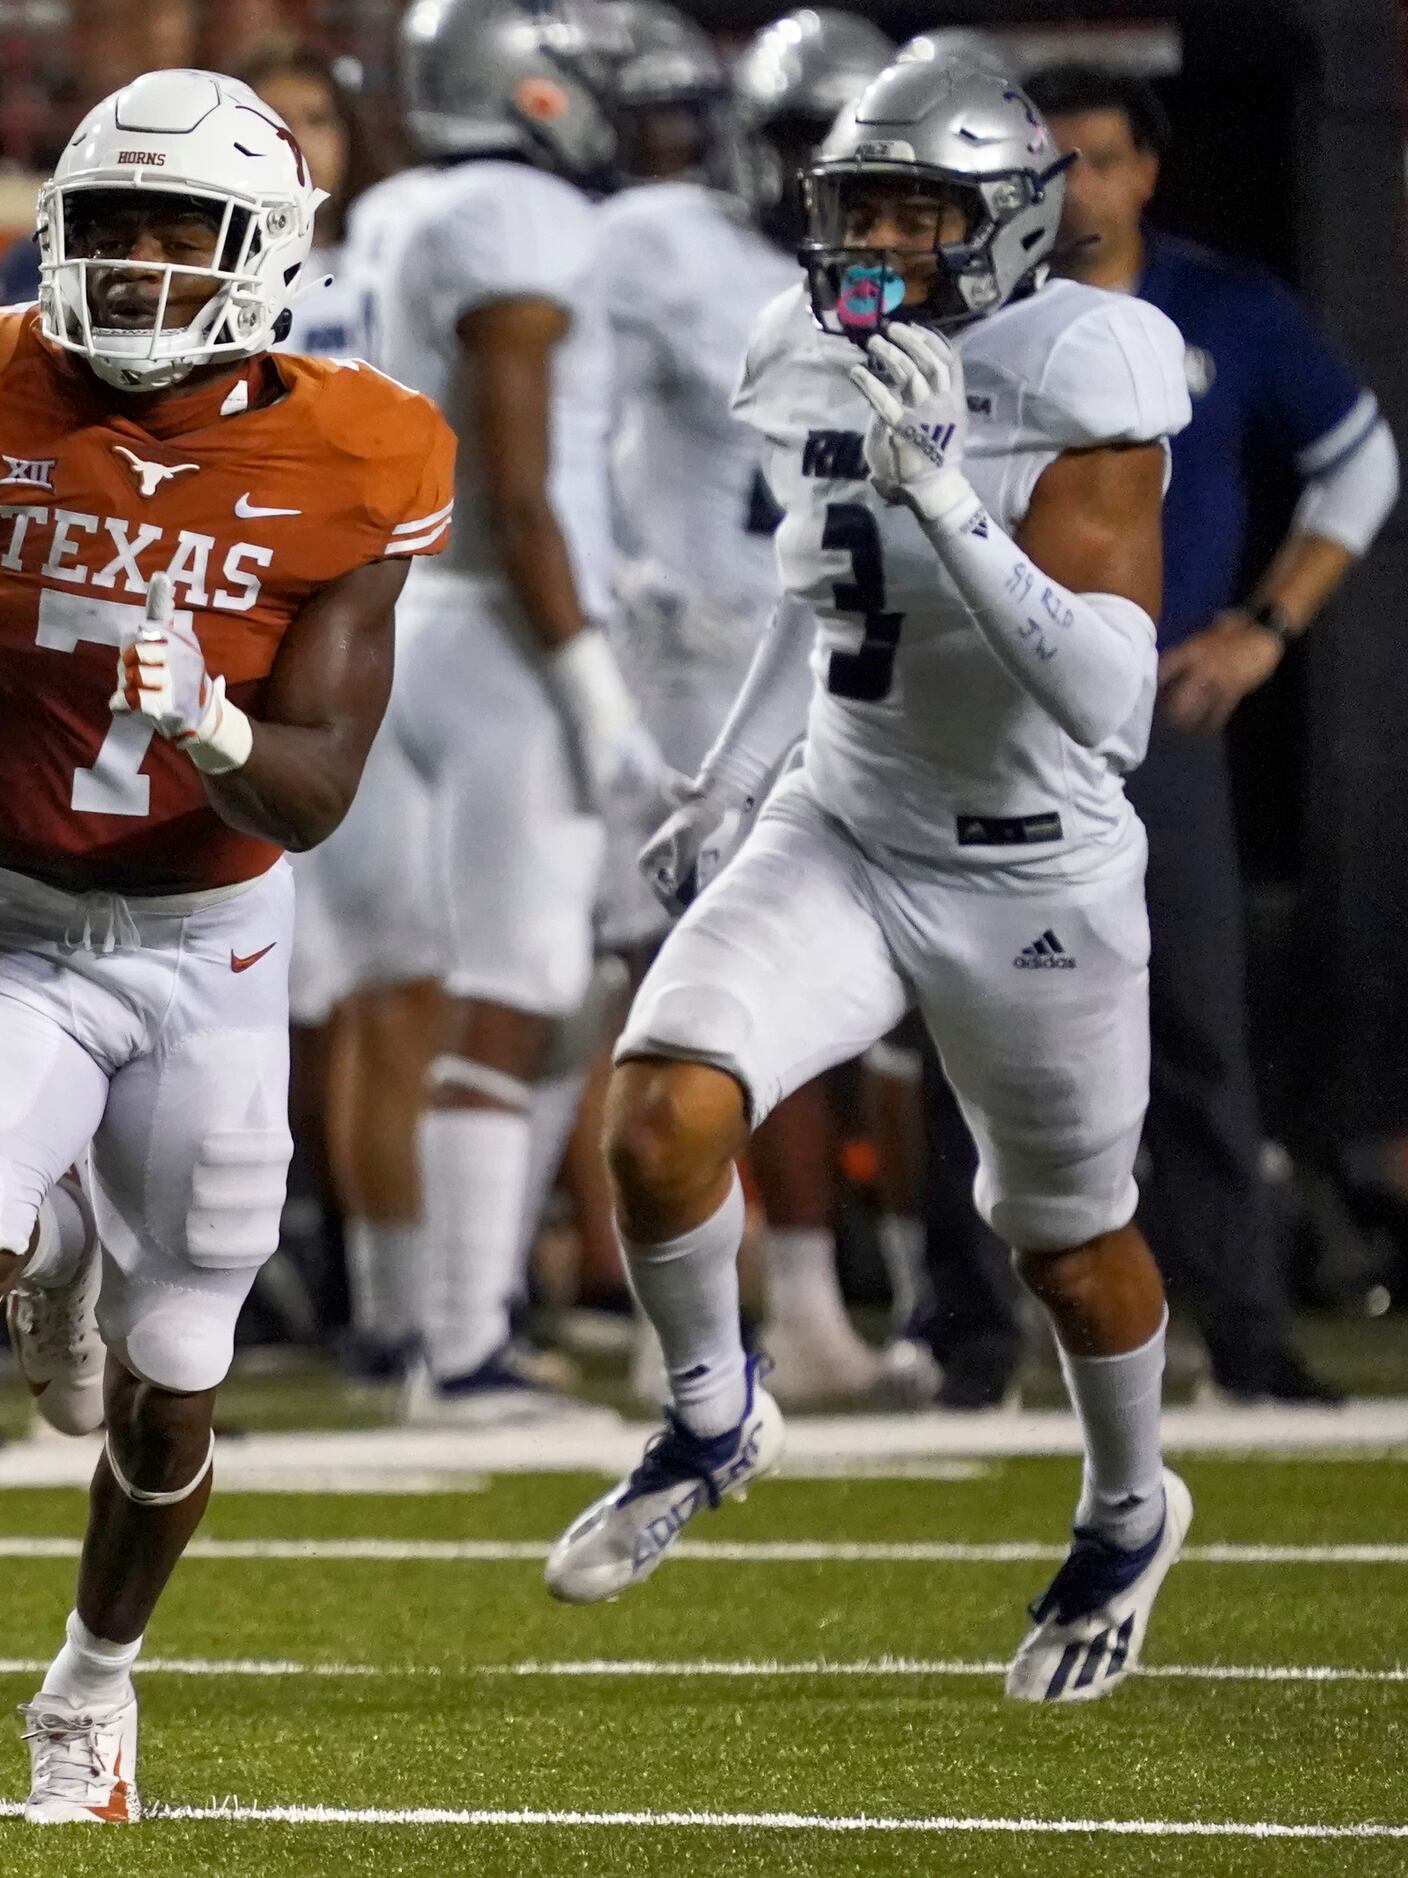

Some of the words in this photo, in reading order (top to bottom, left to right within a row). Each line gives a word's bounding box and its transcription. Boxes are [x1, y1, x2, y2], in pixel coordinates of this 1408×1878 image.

[117, 151, 166, 167] HORNS
[0, 504, 274, 612] TEXAS
[821, 503, 907, 702] 3
[35, 588, 195, 817] 7
[1013, 954, 1077, 970] adidas
